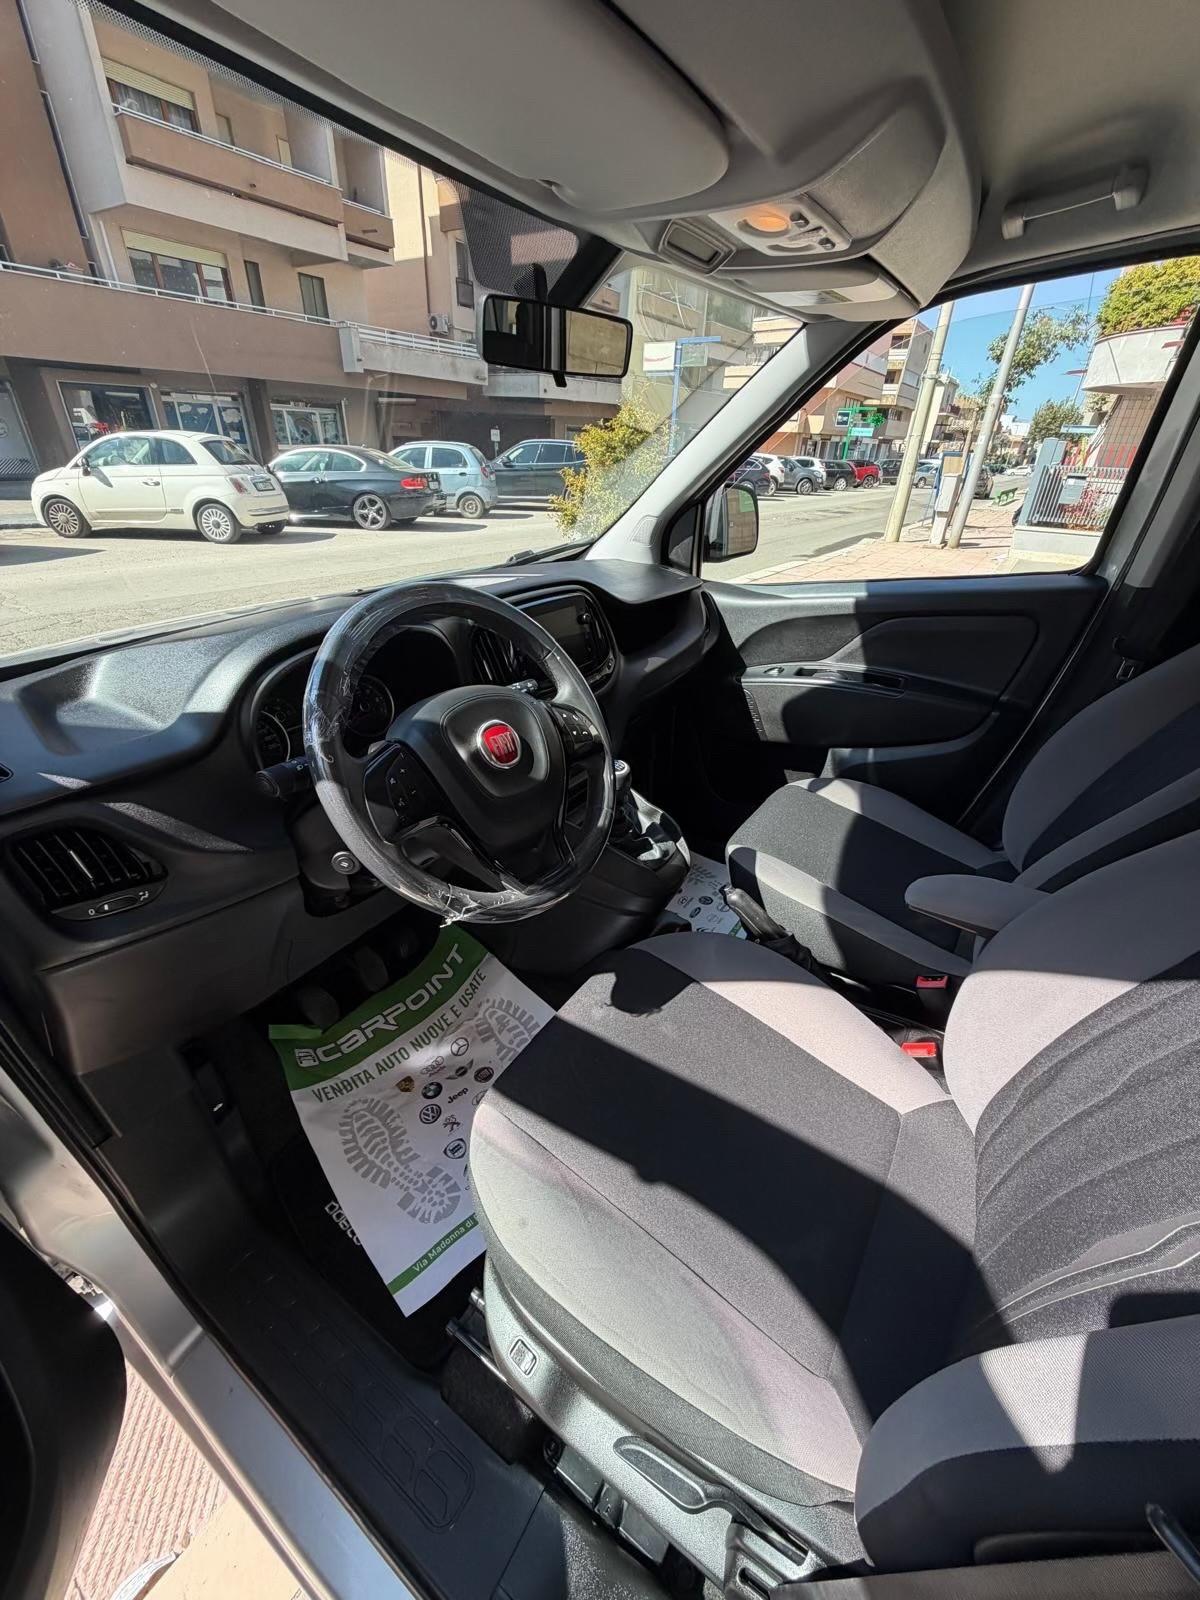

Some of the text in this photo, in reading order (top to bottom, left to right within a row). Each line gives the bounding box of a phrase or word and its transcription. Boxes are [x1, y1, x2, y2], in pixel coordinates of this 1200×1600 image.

[489, 731, 515, 756] FIAT
[315, 943, 464, 1062] CARPOINT
[311, 968, 487, 1103] VENDITA AUTO NUOVE E USATE
[447, 1087, 469, 1104] Jeep
[412, 1219, 475, 1273] Via Madonna di
